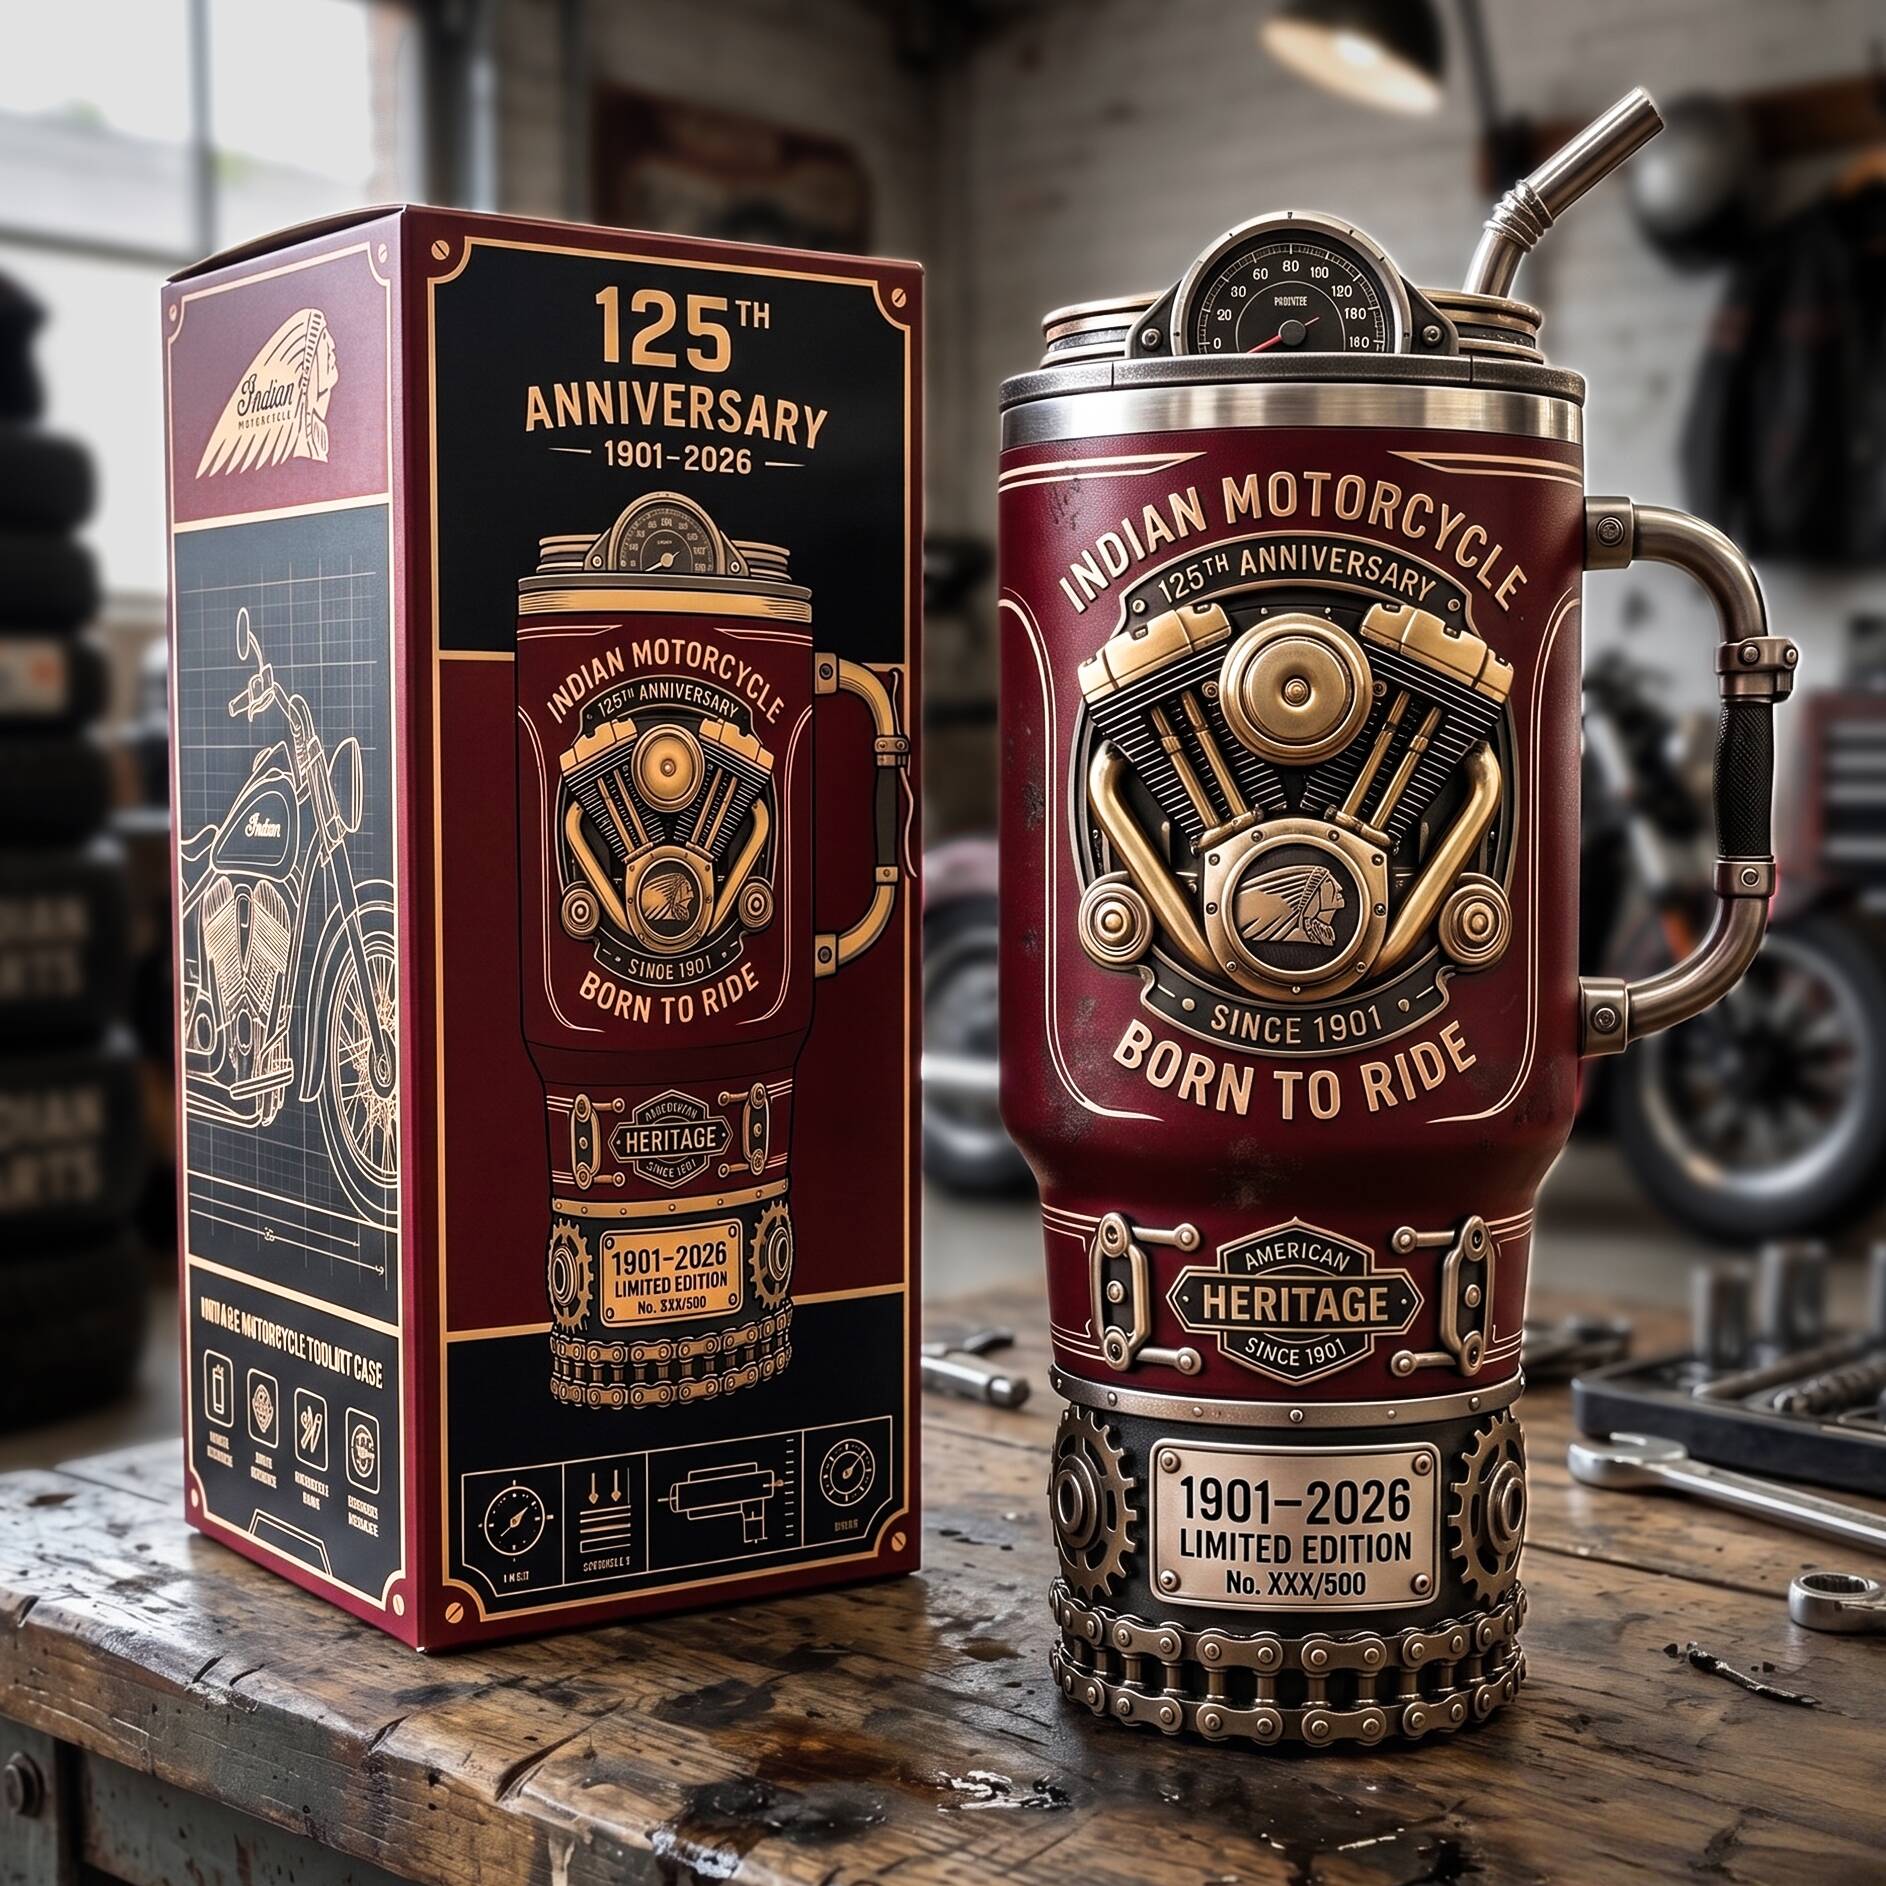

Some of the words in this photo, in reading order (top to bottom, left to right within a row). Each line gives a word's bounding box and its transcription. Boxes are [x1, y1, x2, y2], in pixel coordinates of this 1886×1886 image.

[1253, 268, 1268, 280] 60
[1283, 259, 1299, 272] 80
[1216, 309, 1232, 321] 20
[1213, 338, 1221, 349] 0
[237, 373, 294, 416] Indian
[525, 380, 828, 449] ANNIVERSARY
[604, 440, 751, 475] 1901-2026
[1058, 486, 1207, 614] INDIAN
[1221, 471, 1528, 612] MOTORCYCLE
[1158, 554, 1230, 603] 125TH
[1239, 544, 1437, 602] ANNIVERSARY
[547, 647, 624, 724] INDIAN
[632, 638, 785, 724] MOTORCYCLE
[639, 682, 739, 718] ANNIVERSARY
[679, 955, 712, 979] 1901
[579, 970, 651, 1024] BORN
[660, 995, 694, 1025] TO
[701, 962, 759, 1016] RIDE
[1211, 1004, 1301, 1043] SINCE
[1313, 1005, 1383, 1043] 1901
[1112, 1018, 1255, 1115] BORN
[1273, 1069, 1341, 1120] TO
[1359, 1020, 1477, 1112] RIDE
[626, 1126, 717, 1153] HERITAGE
[612, 1241, 727, 1276] 1901-2026
[1245, 1242, 1350, 1272] AMERICAN
[615, 1277, 671, 1298] LIMITED
[675, 1271, 728, 1292] EDITION
[638, 1301, 656, 1315] No.
[1203, 1284, 1389, 1322] HERITAGE
[1245, 1337, 1300, 1366] SINCE
[1305, 1338, 1346, 1365] 1901
[354, 1354, 383, 1389] CASE
[1180, 1475, 1410, 1525] 1901-2026
[1180, 1528, 1291, 1564] LIMITED
[1303, 1532, 1411, 1564] EDITION
[1226, 1570, 1260, 1595] No.
[1267, 1572, 1366, 1600] XXX/500
